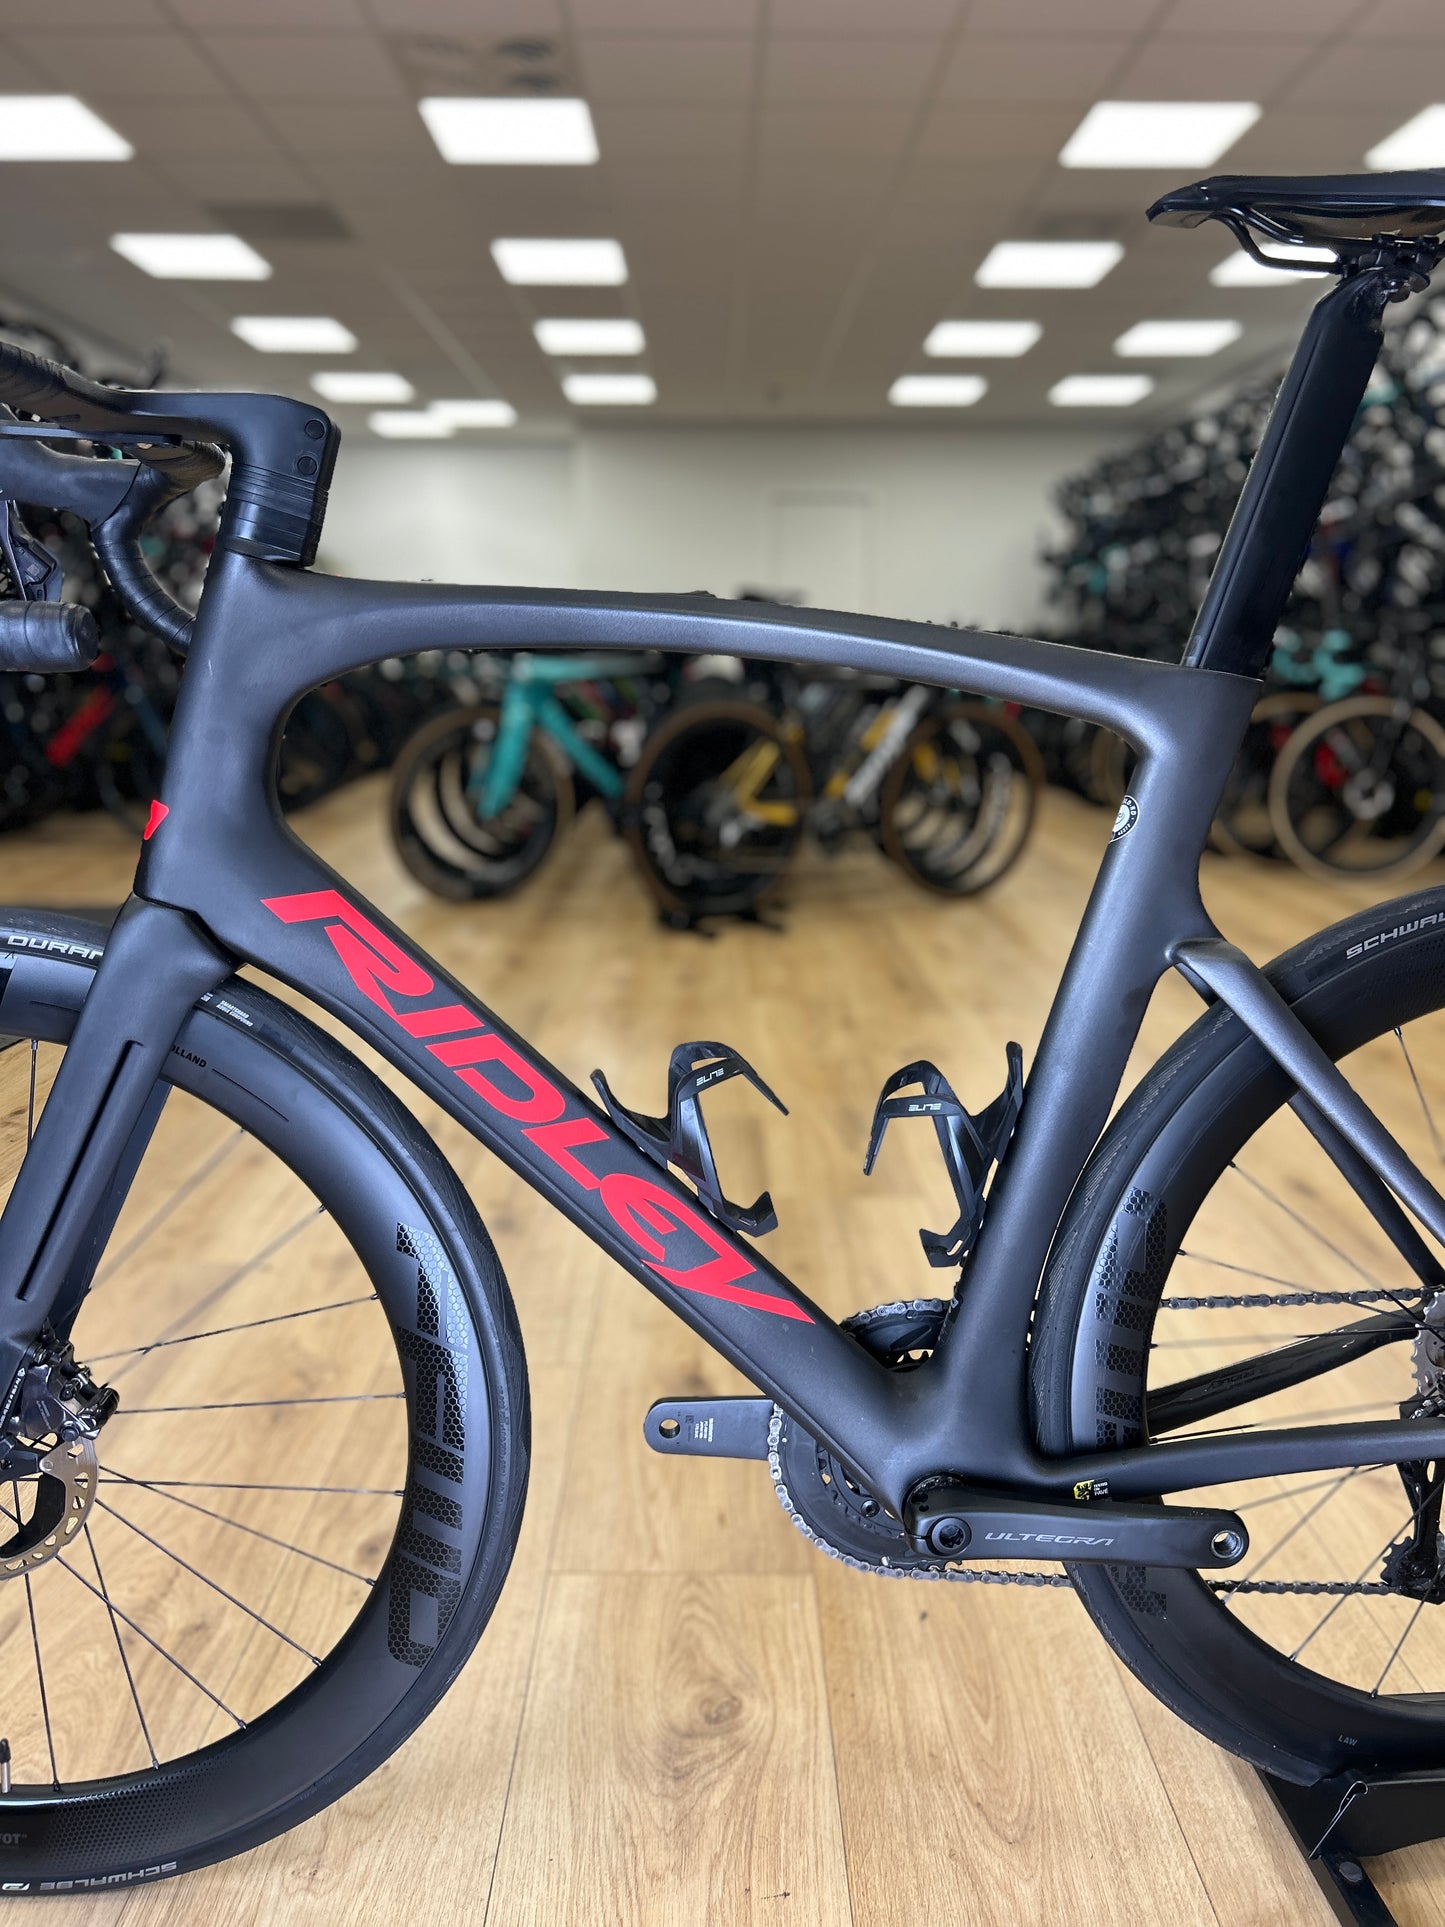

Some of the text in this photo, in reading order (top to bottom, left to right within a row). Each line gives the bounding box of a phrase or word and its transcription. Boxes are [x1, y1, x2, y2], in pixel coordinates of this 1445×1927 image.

[261, 890, 816, 1324] RIDLEY
[984, 1532, 1115, 1547] ULTEGRA
[40, 1861, 177, 1891] SCHWALBE
